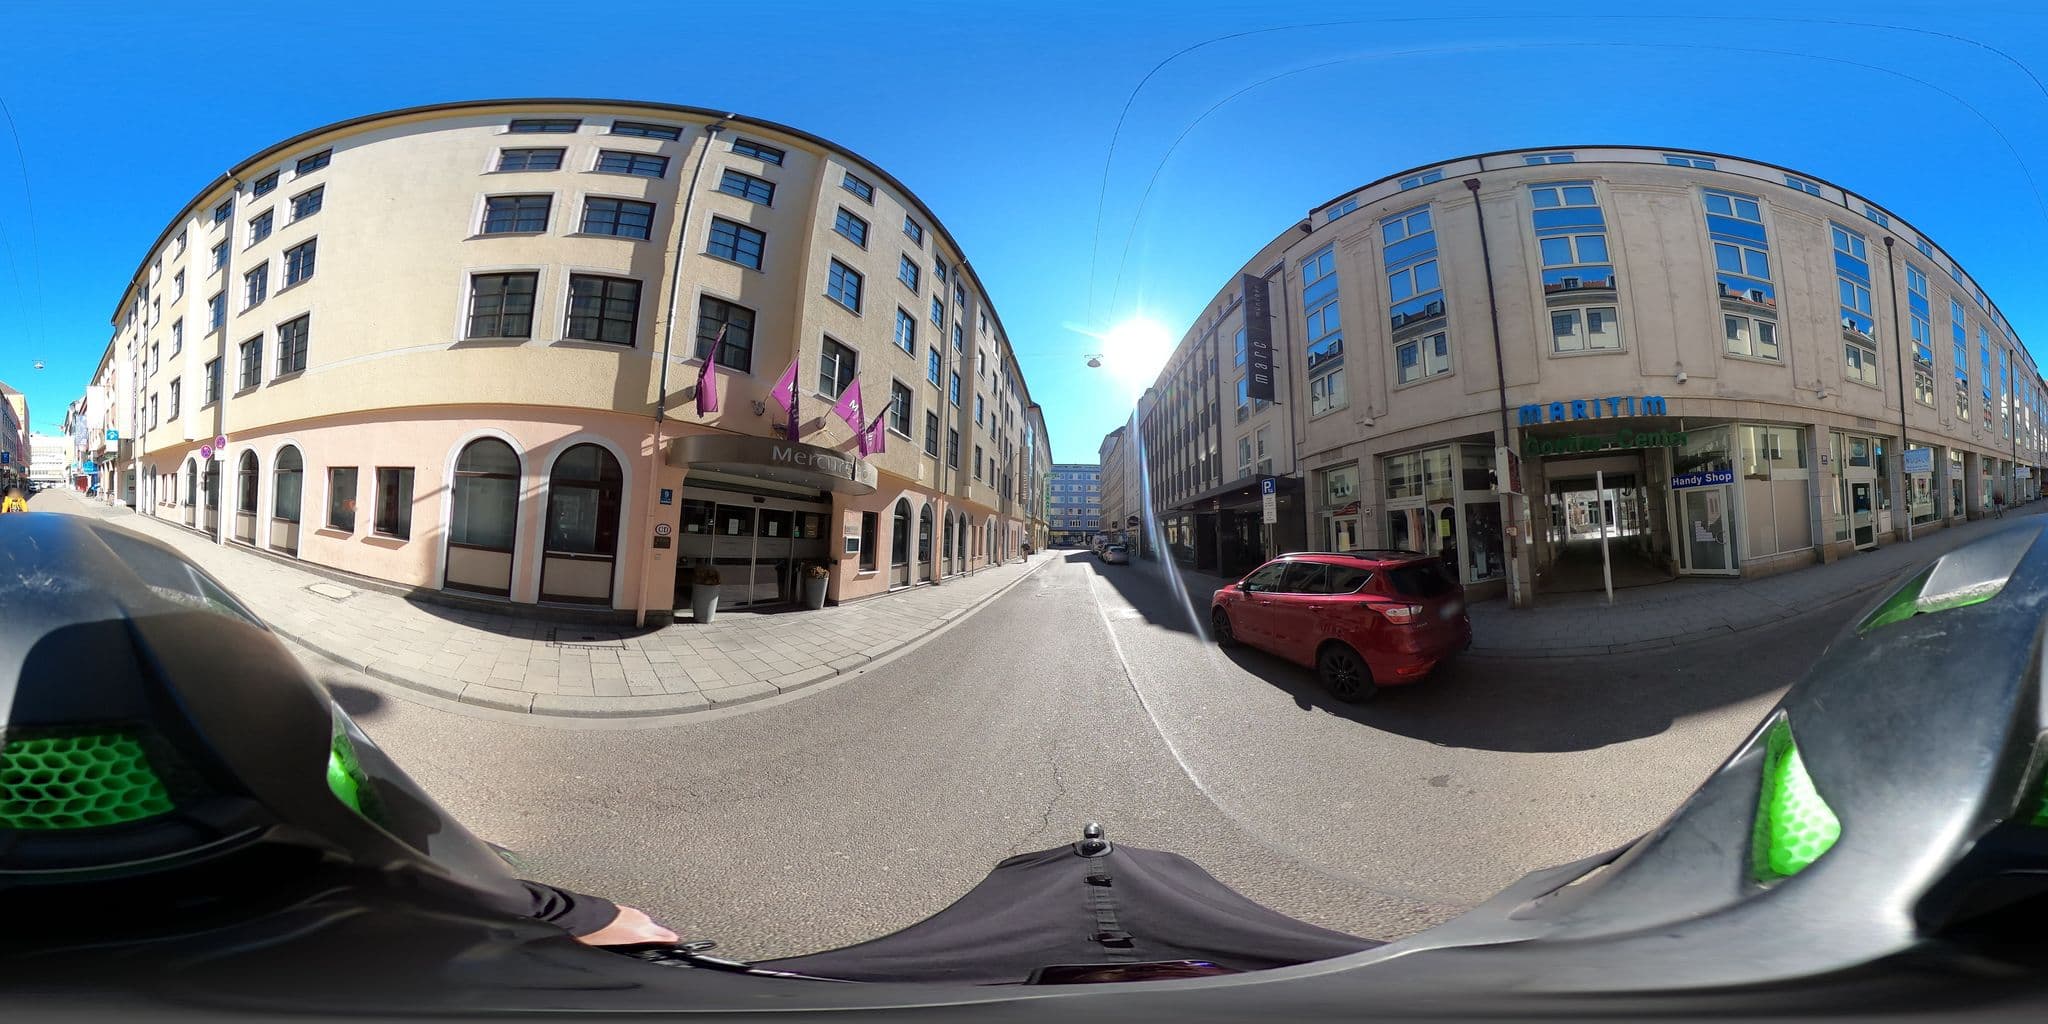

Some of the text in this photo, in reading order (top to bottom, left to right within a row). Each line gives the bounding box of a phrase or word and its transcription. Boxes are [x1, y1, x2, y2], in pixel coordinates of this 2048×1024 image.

[1253, 341, 1269, 384] marc
[1519, 395, 1667, 425] MARITIM
[772, 445, 853, 474] Mercure
[1264, 481, 1271, 493] P
[1672, 473, 1732, 486] Handy Shop
